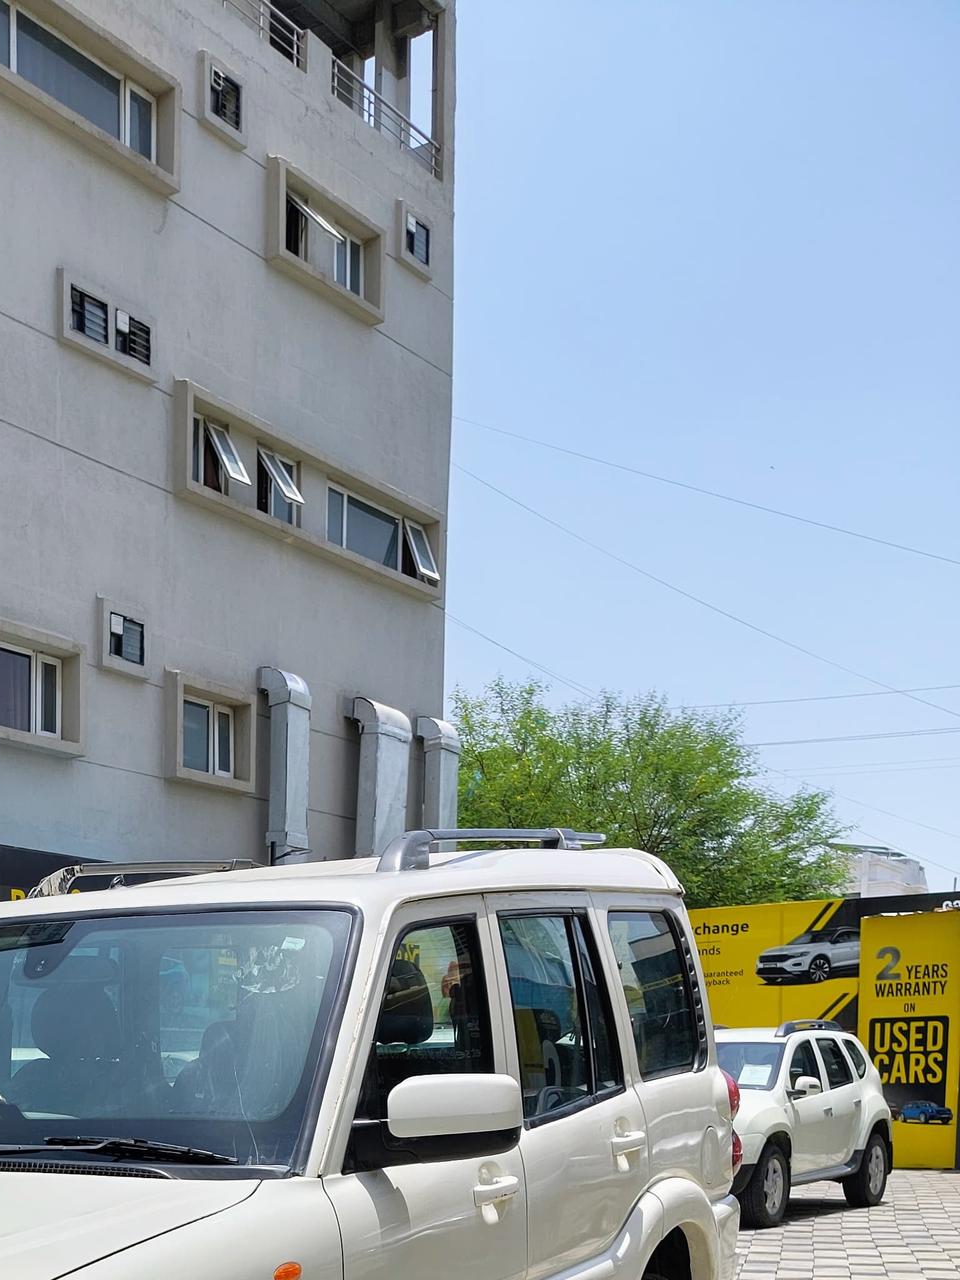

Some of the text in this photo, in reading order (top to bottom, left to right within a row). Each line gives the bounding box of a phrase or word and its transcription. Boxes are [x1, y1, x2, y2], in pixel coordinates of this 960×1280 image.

[692, 922, 750, 936] change
[876, 946, 948, 981] 2 YEARS
[703, 969, 744, 978] uaranteed
[875, 980, 948, 998] WARRANTY
[903, 1002, 916, 1013] ON
[874, 1020, 944, 1053] USED
[874, 1052, 943, 1084] CARS
